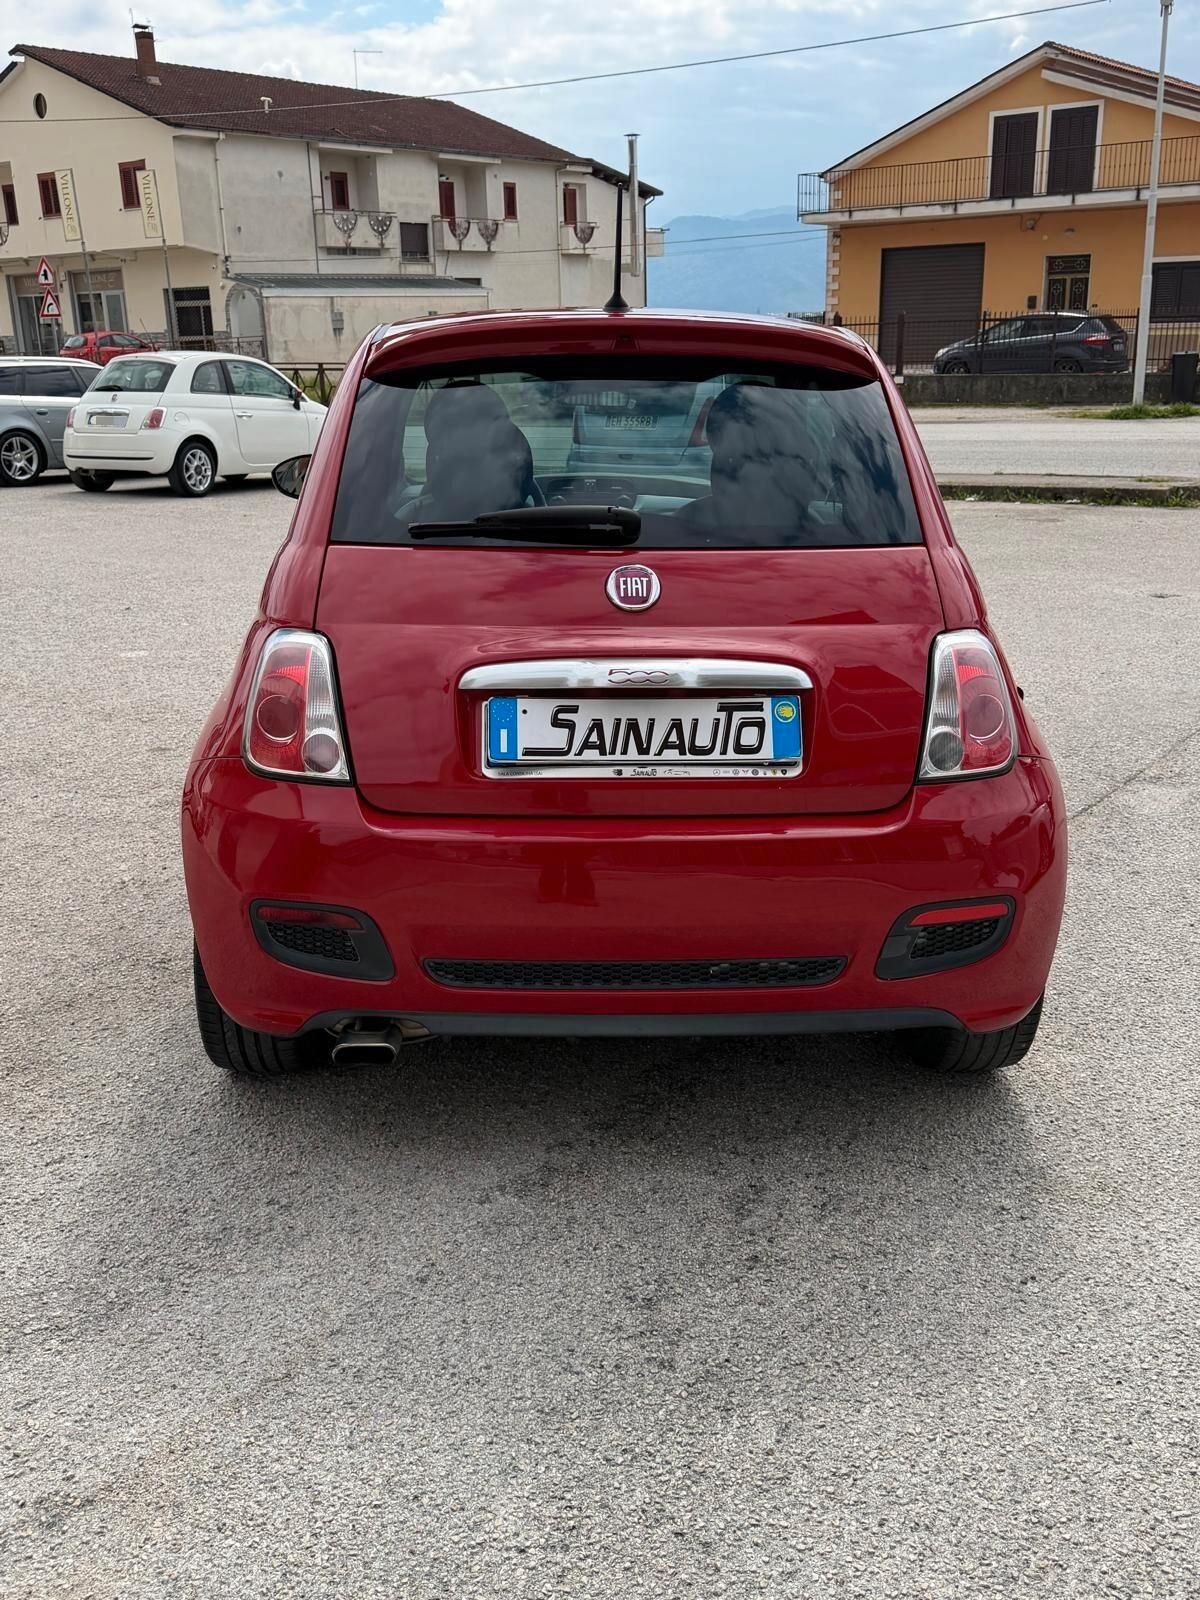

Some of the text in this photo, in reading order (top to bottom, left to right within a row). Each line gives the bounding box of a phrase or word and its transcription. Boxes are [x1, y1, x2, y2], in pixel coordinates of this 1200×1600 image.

[60, 173, 75, 223] VILLONE
[142, 174, 156, 222] VILLONE
[620, 577, 649, 597] FIAT
[608, 668, 669, 684] 500
[522, 701, 766, 757] SAINAUTO
